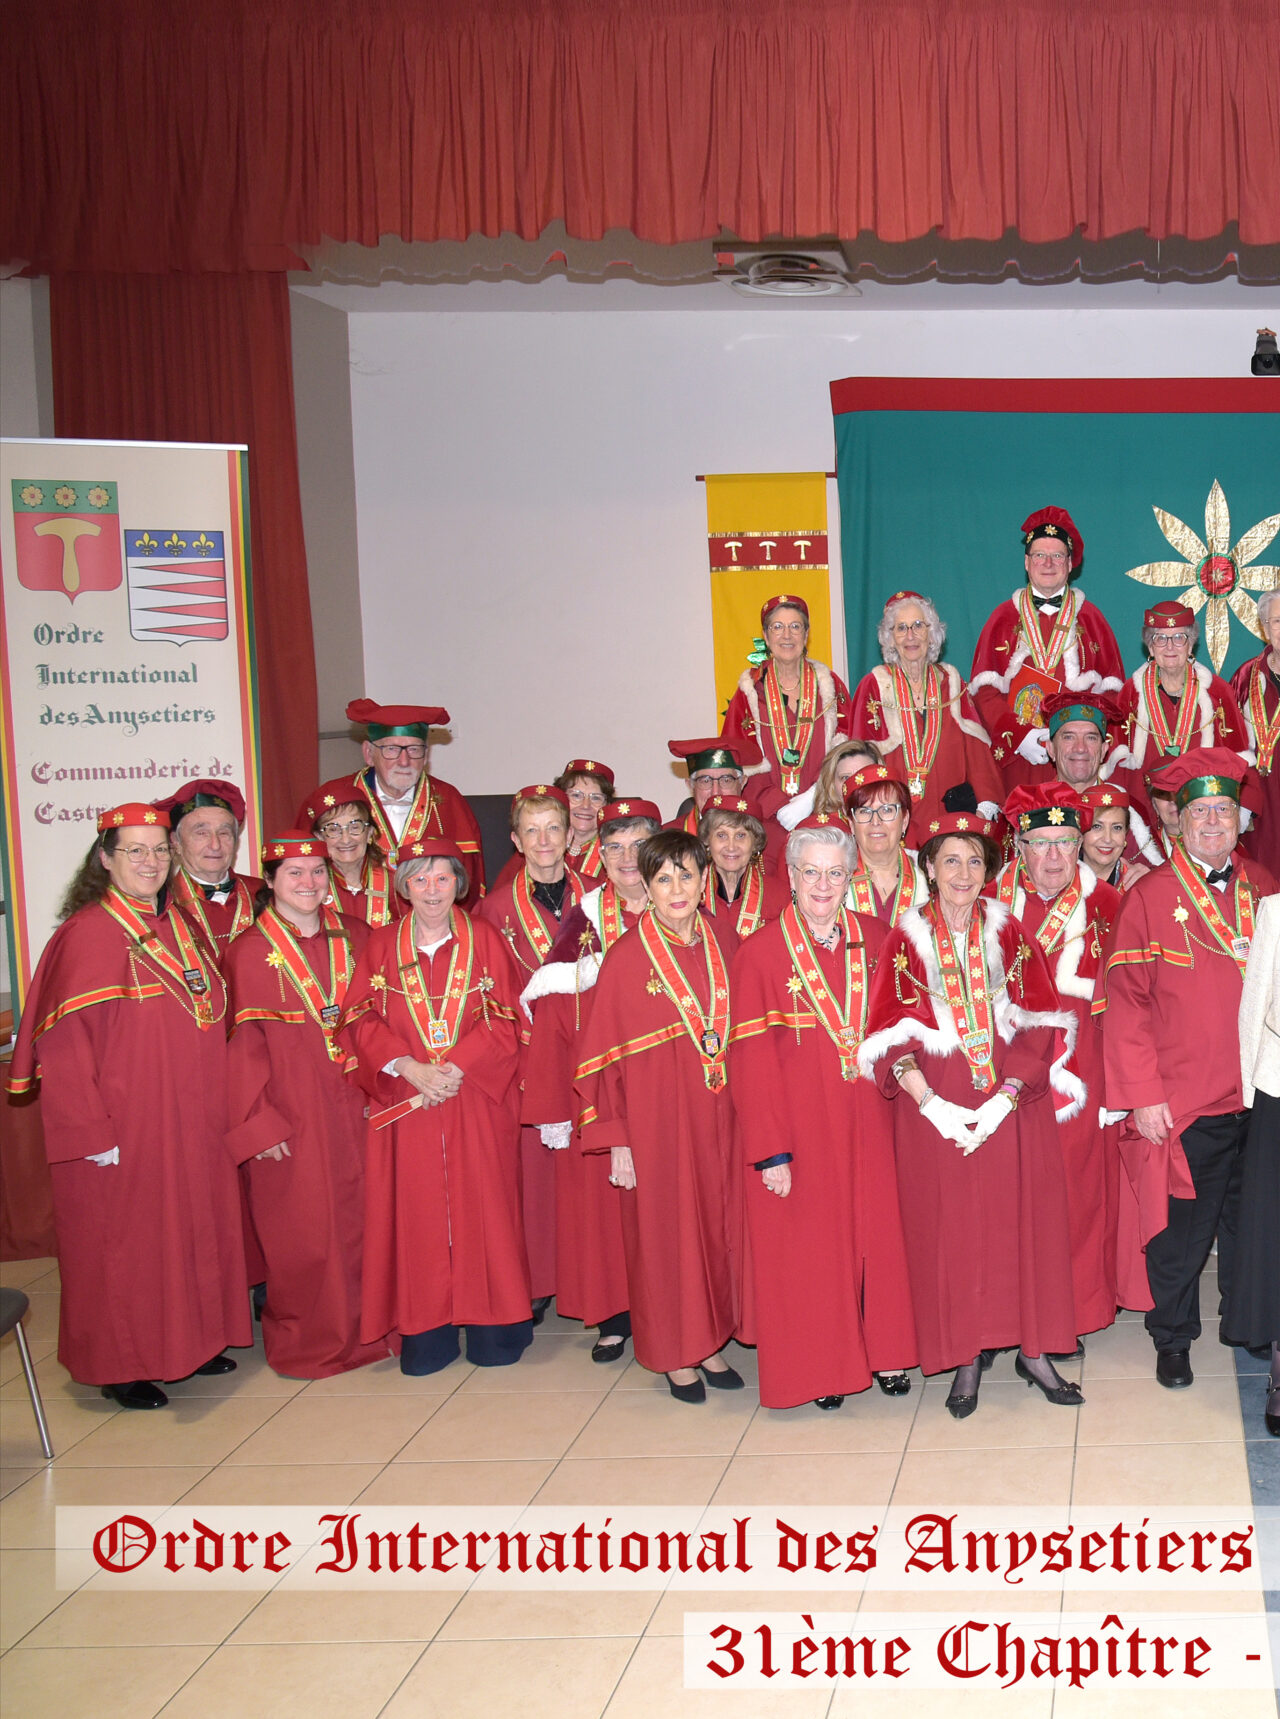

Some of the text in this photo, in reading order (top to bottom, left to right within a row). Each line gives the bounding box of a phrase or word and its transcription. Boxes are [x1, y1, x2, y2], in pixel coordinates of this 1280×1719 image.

[33, 622, 105, 646] Ordre
[34, 662, 199, 690] International
[30, 755, 234, 786] Commanderie de
